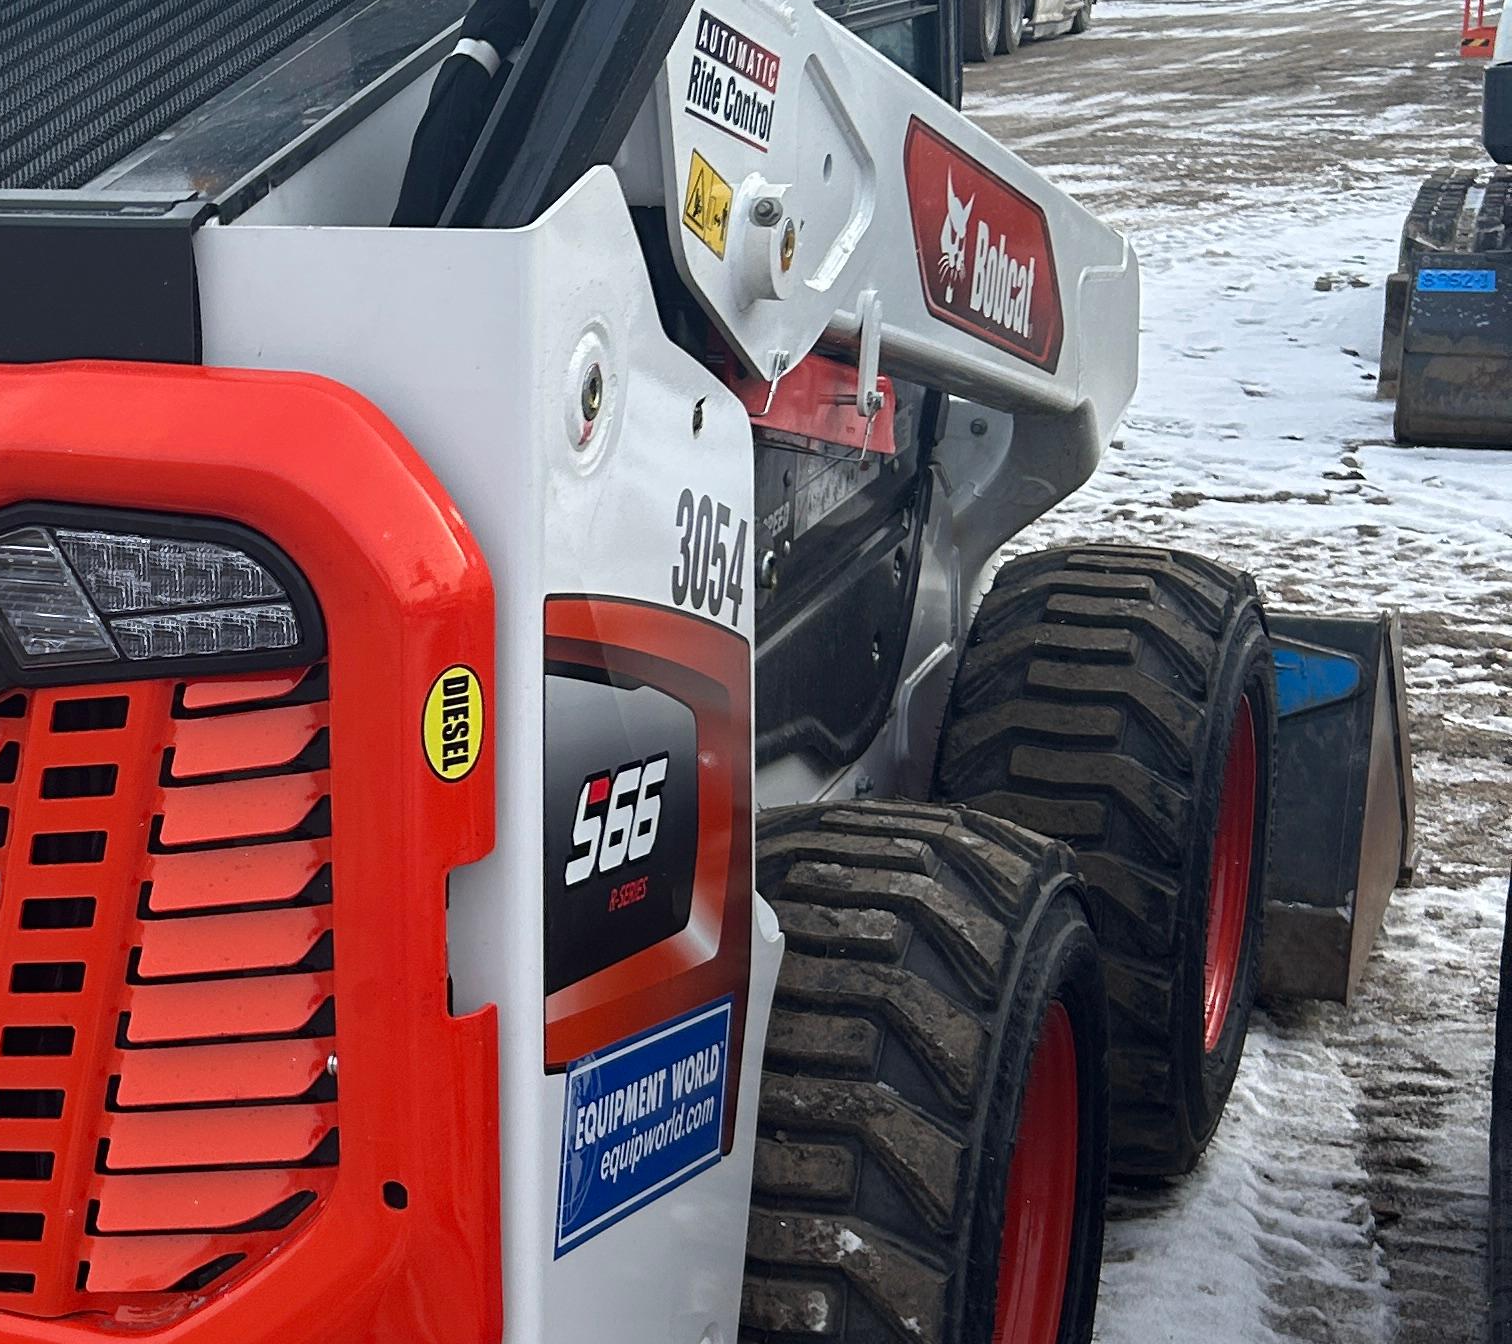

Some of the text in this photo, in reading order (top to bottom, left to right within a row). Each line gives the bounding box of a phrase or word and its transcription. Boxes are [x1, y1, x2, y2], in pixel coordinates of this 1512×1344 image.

[687, 55, 776, 142] Ride Control
[698, 19, 777, 88] AUTOMATIC
[970, 220, 1035, 338] Bobcat
[671, 488, 747, 626] 3054
[442, 675, 469, 771] DIESEL
[564, 757, 669, 886] S66
[608, 876, 648, 912] R-SERIES
[574, 1044, 720, 1151] EQUIPMENT WORLD
[600, 1096, 715, 1184] equipworld.com
